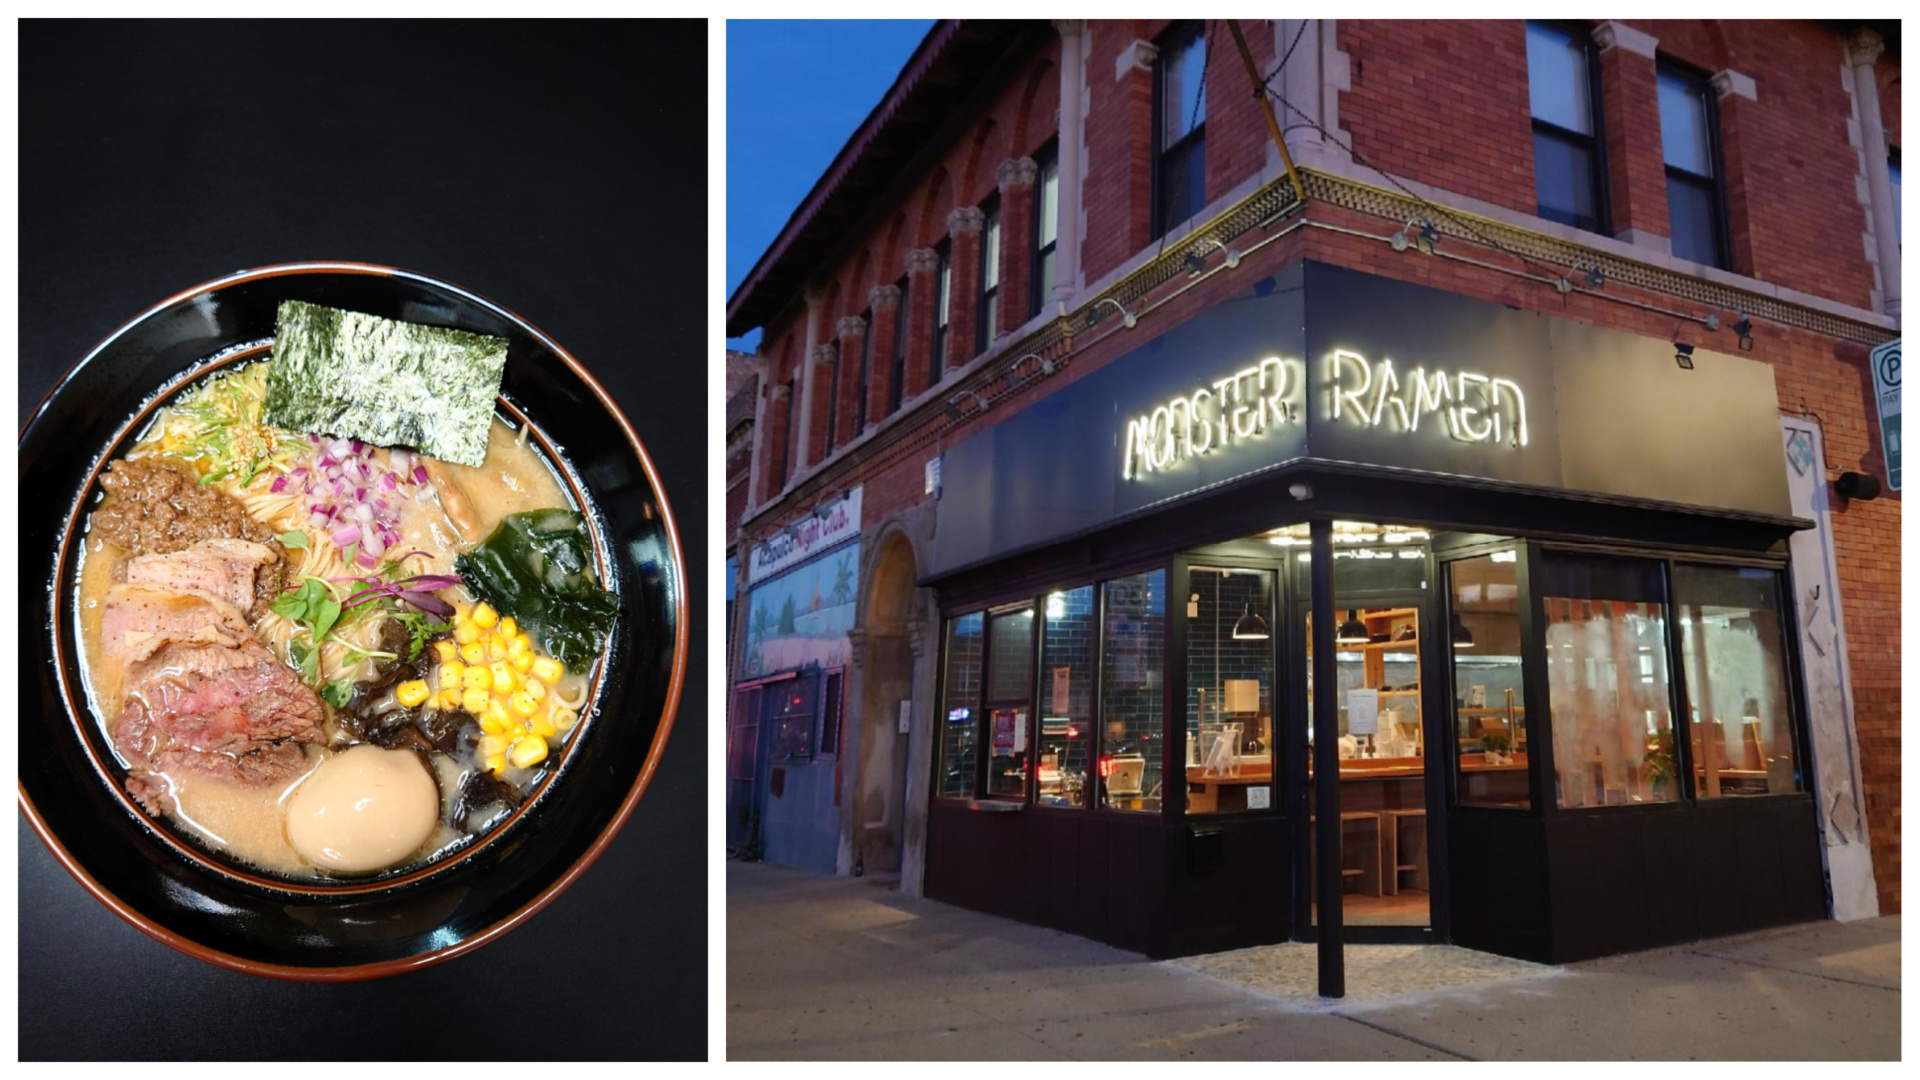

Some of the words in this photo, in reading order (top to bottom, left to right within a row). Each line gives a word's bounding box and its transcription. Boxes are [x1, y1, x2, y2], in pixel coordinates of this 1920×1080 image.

[1887, 357, 1901, 380] P
[1123, 356, 1291, 480] MONSTER
[1332, 349, 1529, 447] RAMEN
